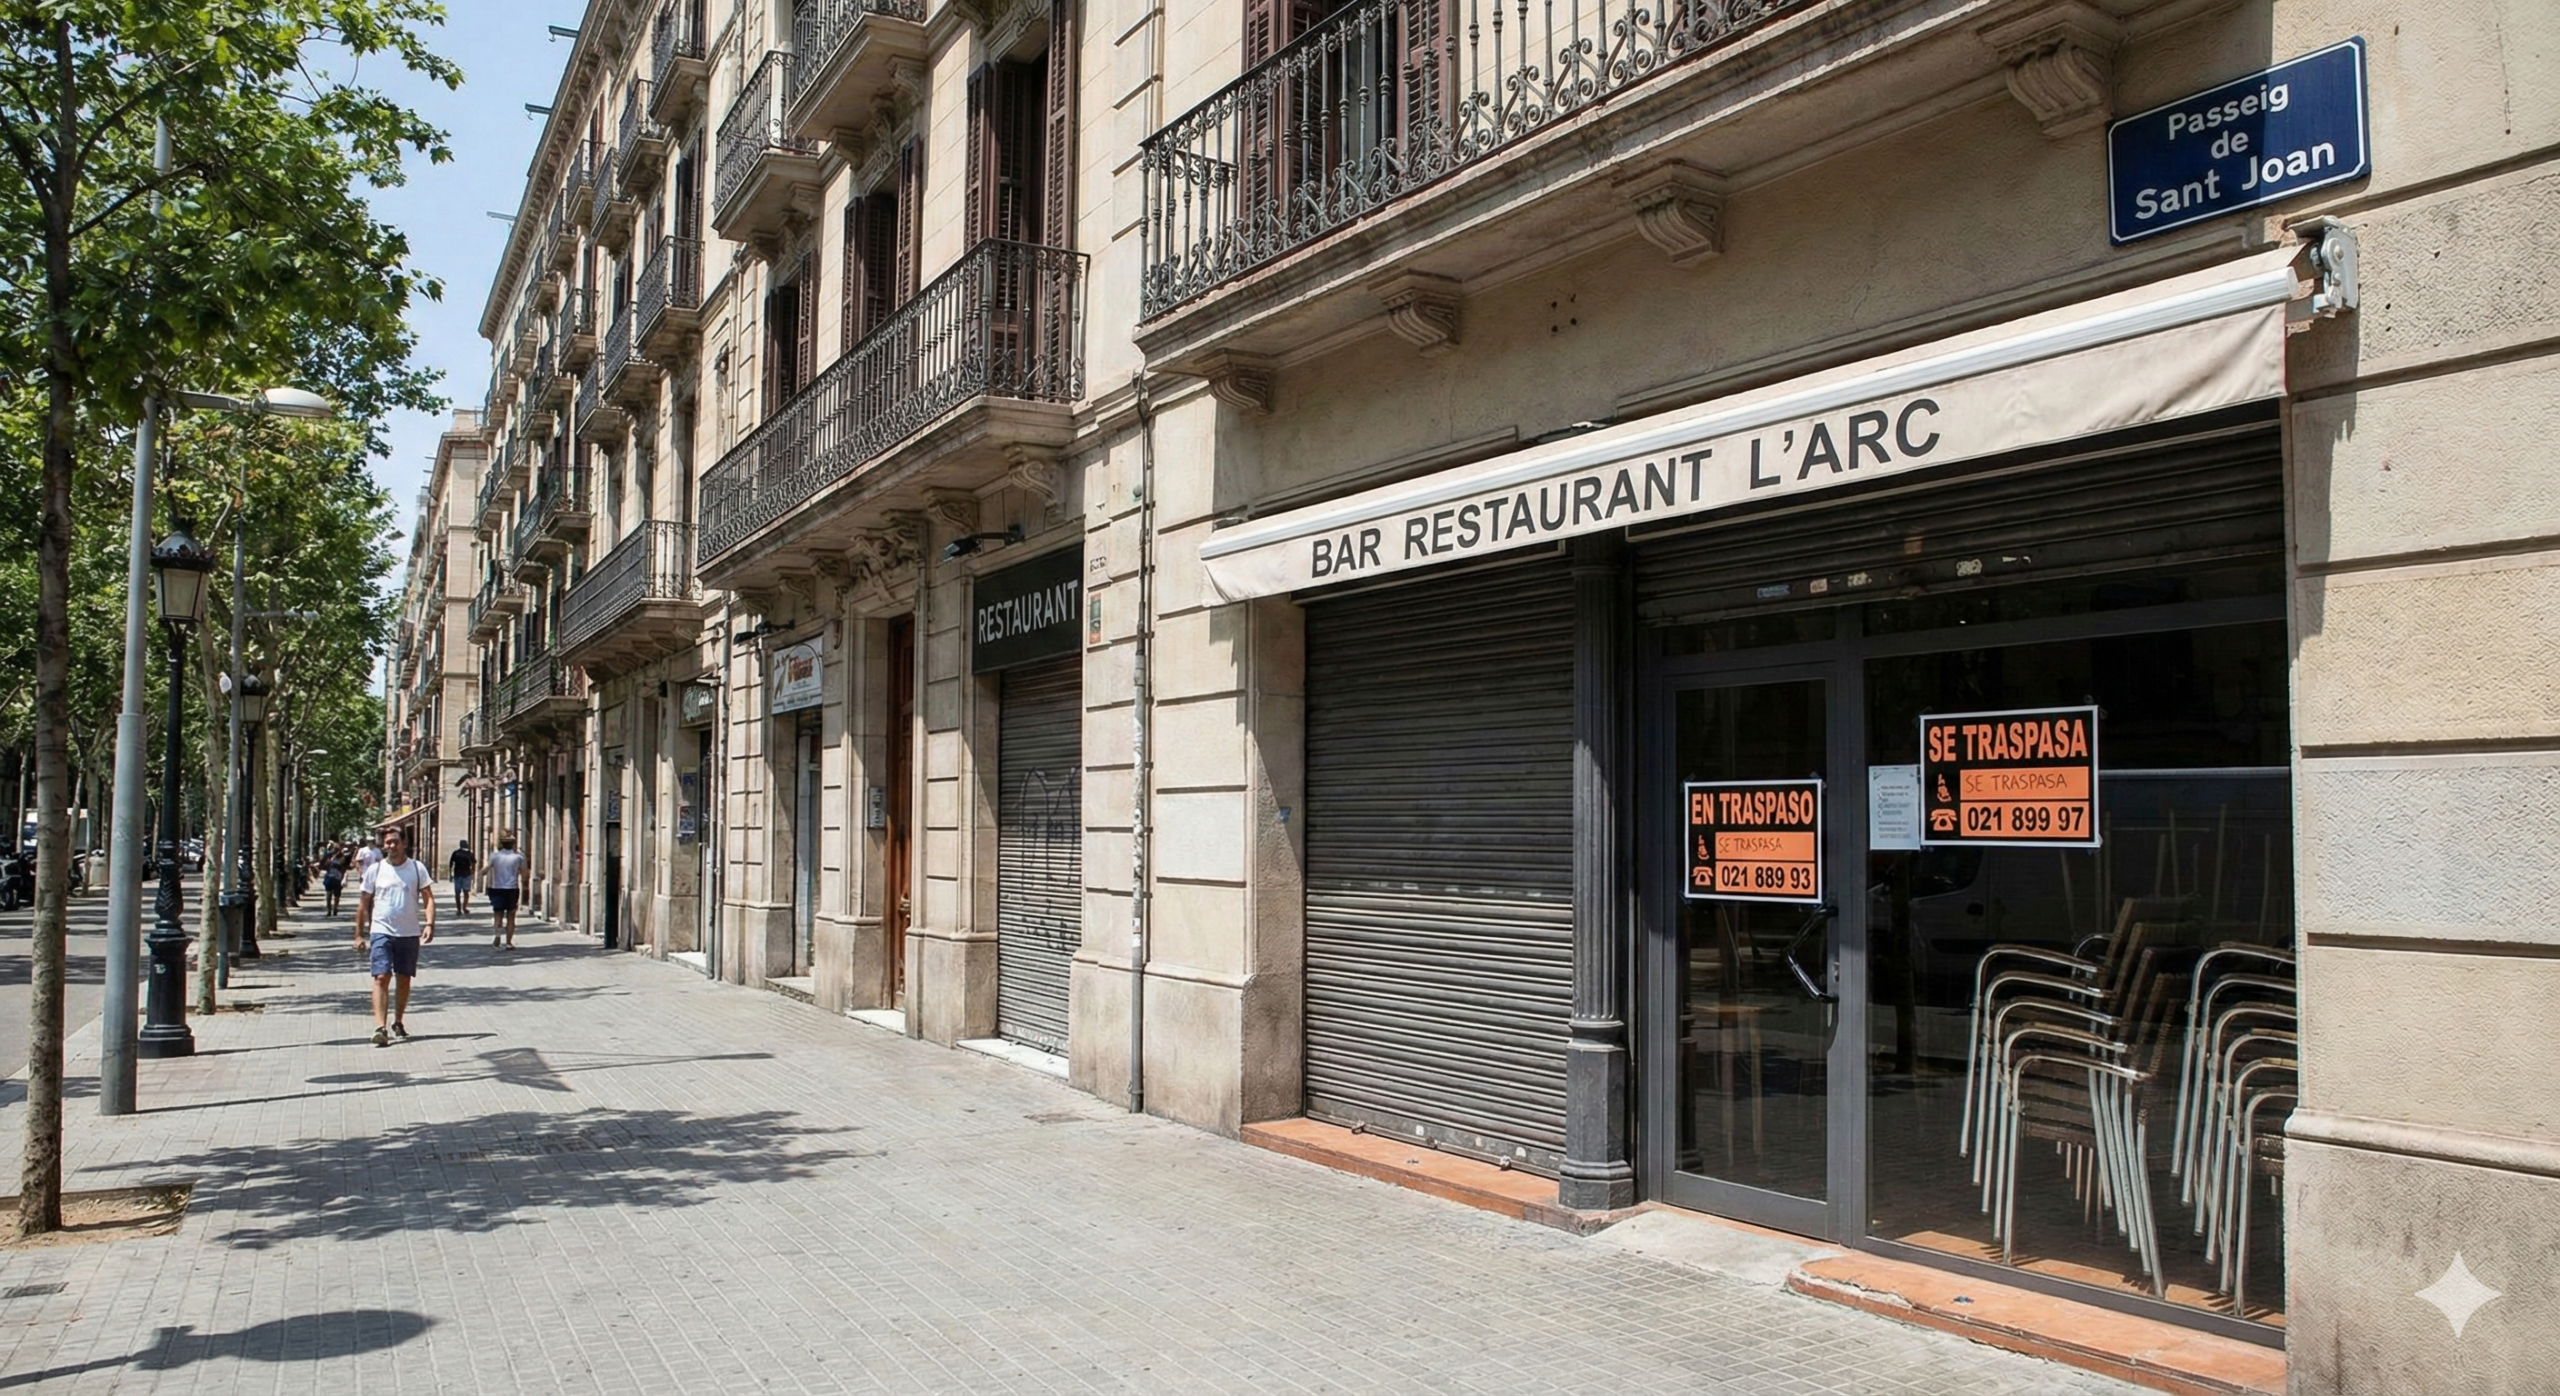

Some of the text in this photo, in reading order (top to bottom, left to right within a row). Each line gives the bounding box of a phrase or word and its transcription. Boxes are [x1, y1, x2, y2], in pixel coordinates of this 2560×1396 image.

[2168, 82, 2290, 141] Passeig
[2210, 129, 2249, 160] de
[2134, 140, 2335, 220] Sant Joan
[1311, 398, 1941, 579] BAR RESTAURANT L'ARC
[978, 579, 1078, 645] RESTAURANT
[1928, 719, 2088, 762] SE TRASPASA
[1965, 773, 2068, 794] SE TRASPASA
[1691, 790, 1814, 825] EN TRASPASO
[1967, 806, 2085, 831] 021 899 97
[1718, 836, 1731, 854] SE
[1721, 865, 1811, 890] 021 889 93
